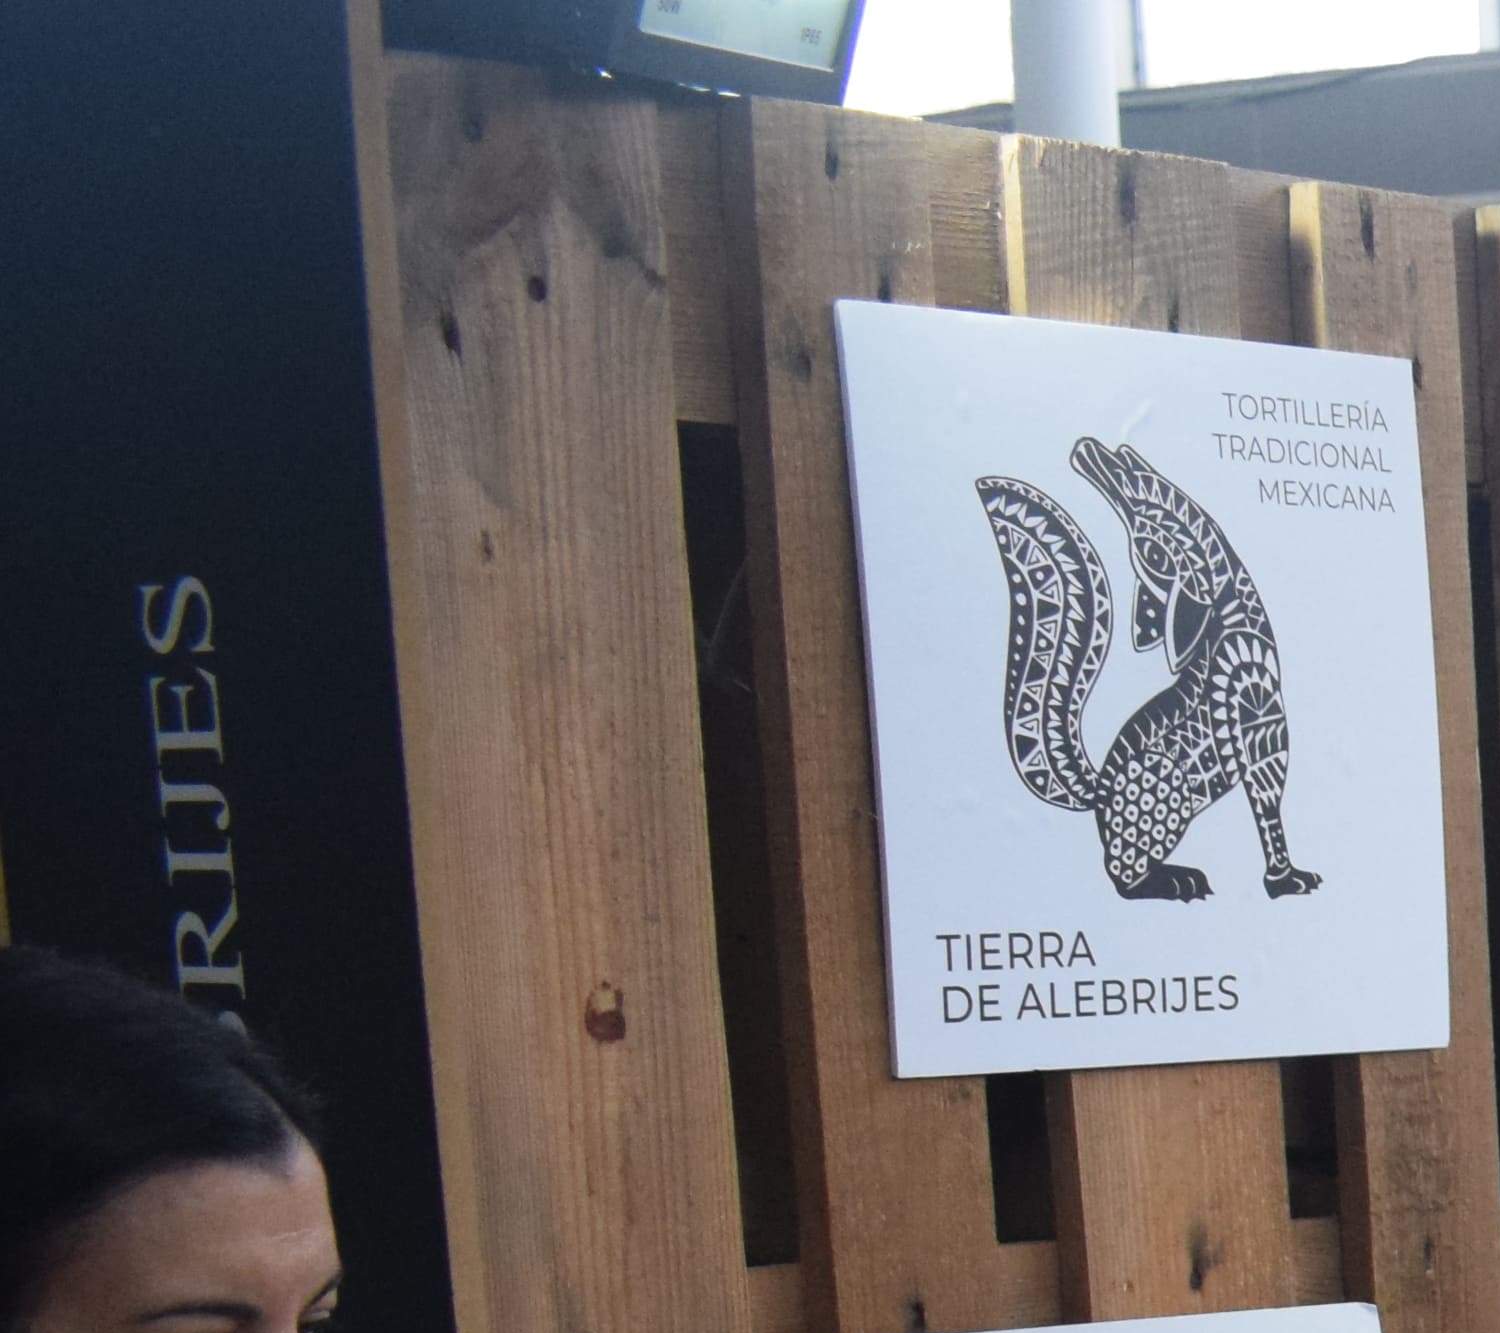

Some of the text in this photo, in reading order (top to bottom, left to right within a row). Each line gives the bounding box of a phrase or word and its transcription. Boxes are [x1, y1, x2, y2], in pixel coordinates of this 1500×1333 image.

[1220, 391, 1388, 432] TORTILLERÍA
[1211, 433, 1391, 472] TRADICIONAL
[1258, 480, 1395, 513] MEXICANA
[139, 575, 247, 1036] RIJES
[936, 930, 1096, 973] TIERRA
[942, 974, 1239, 1023] DE ALEBRIJES
